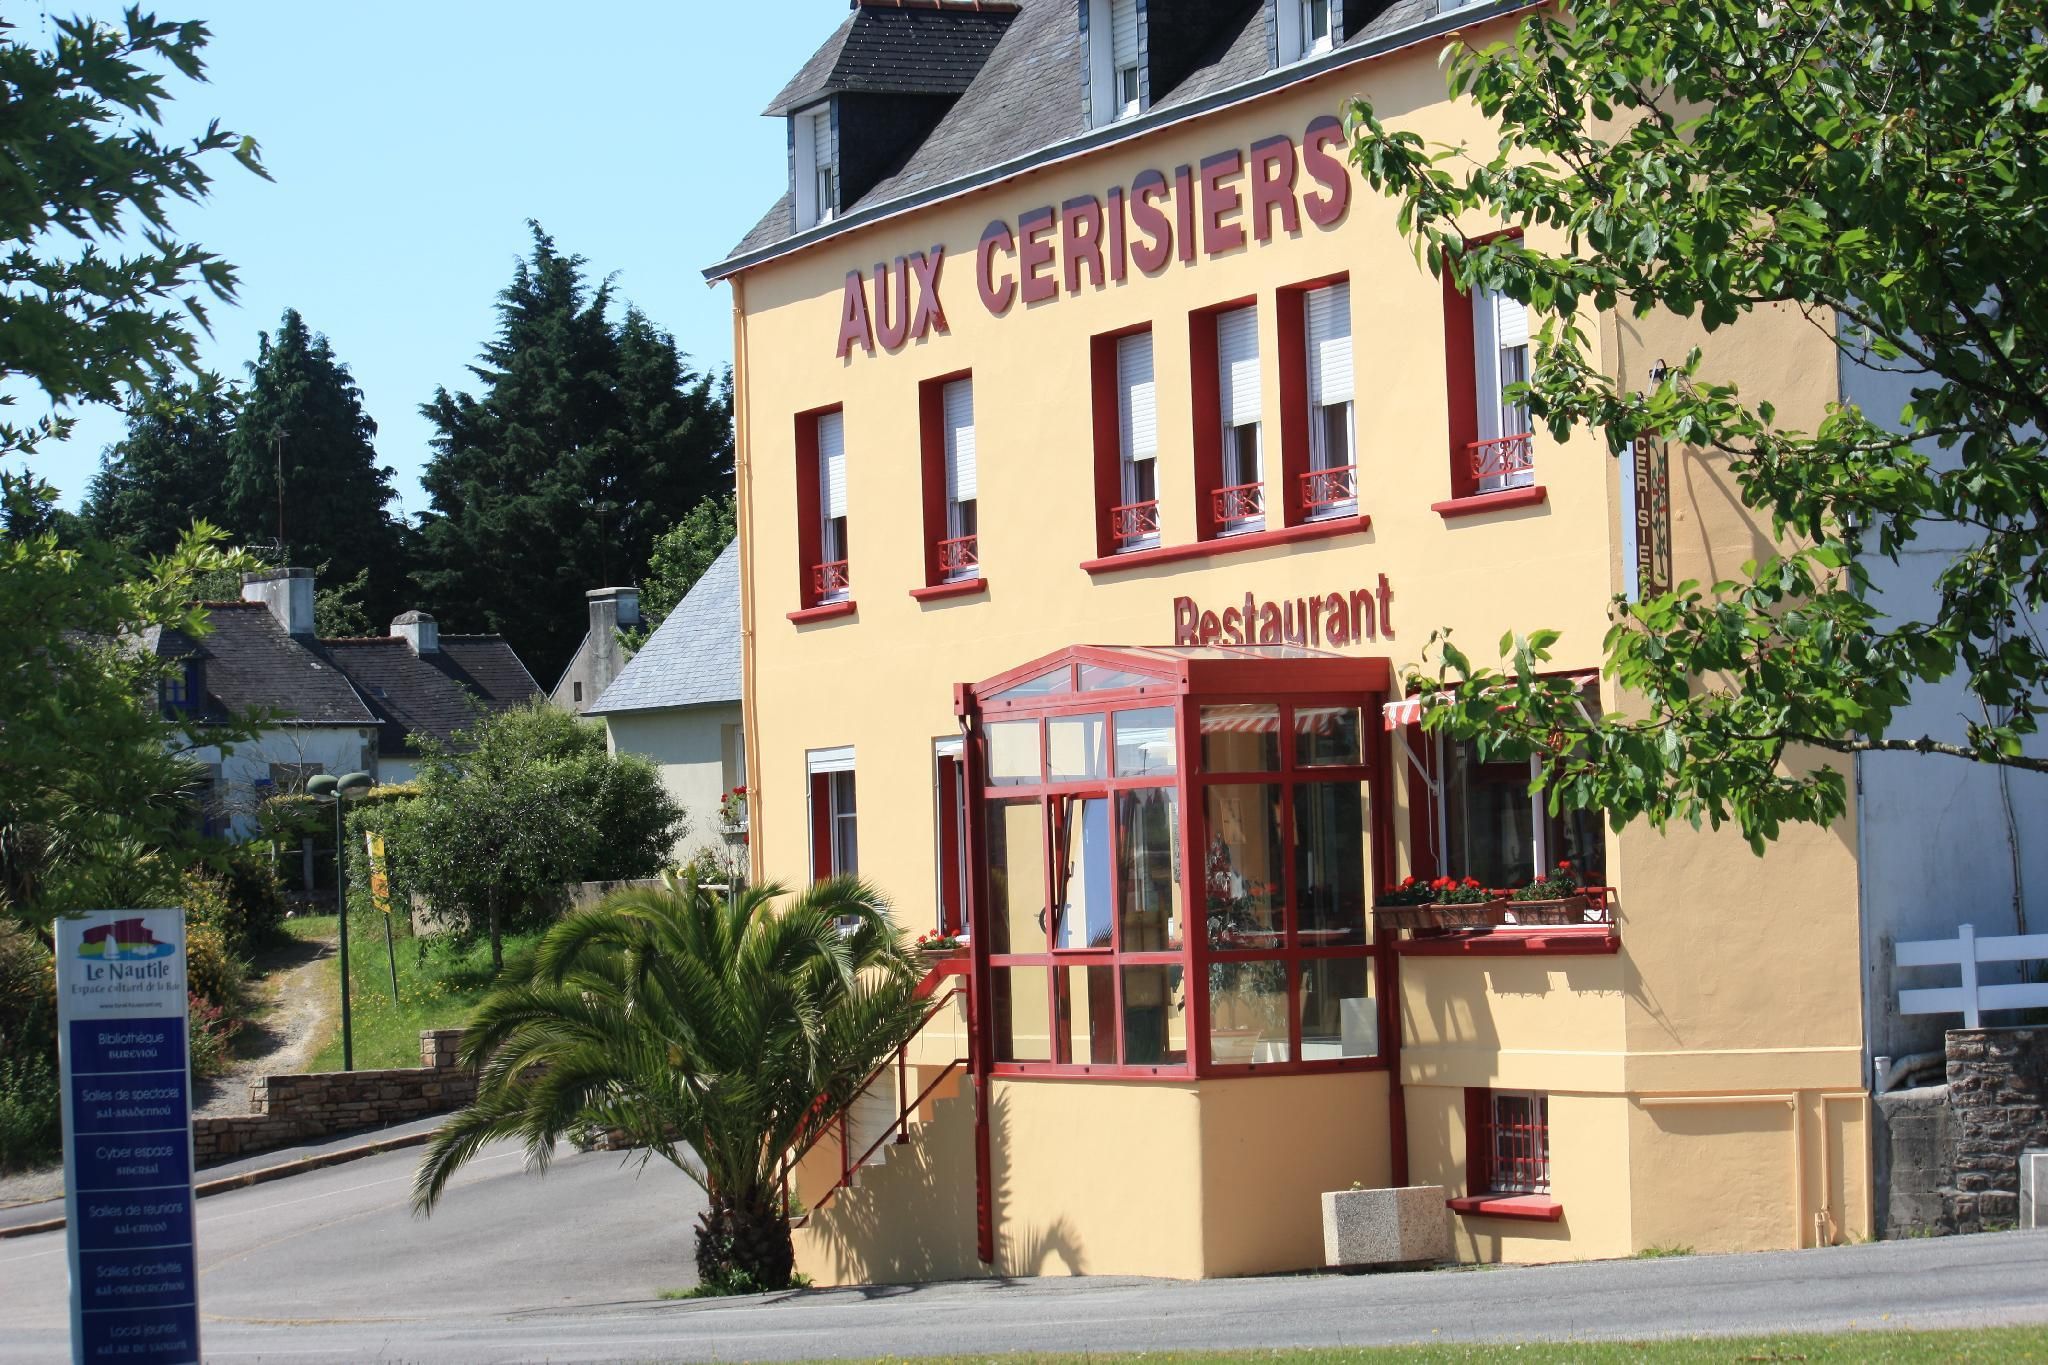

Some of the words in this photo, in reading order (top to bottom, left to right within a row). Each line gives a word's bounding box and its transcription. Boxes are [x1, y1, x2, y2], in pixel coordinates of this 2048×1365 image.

[836, 244, 949, 359] AUX
[977, 115, 1352, 314] CERISIERS
[1173, 573, 1395, 648] Restaurant
[86, 964, 105, 981] Le
[109, 961, 170, 980] Nautile
[82, 1089, 113, 1102] Salles
[115, 1088, 131, 1101] de
[95, 1147, 131, 1160] Cyber
[134, 1145, 174, 1159] espace
[125, 1203, 142, 1216] de
